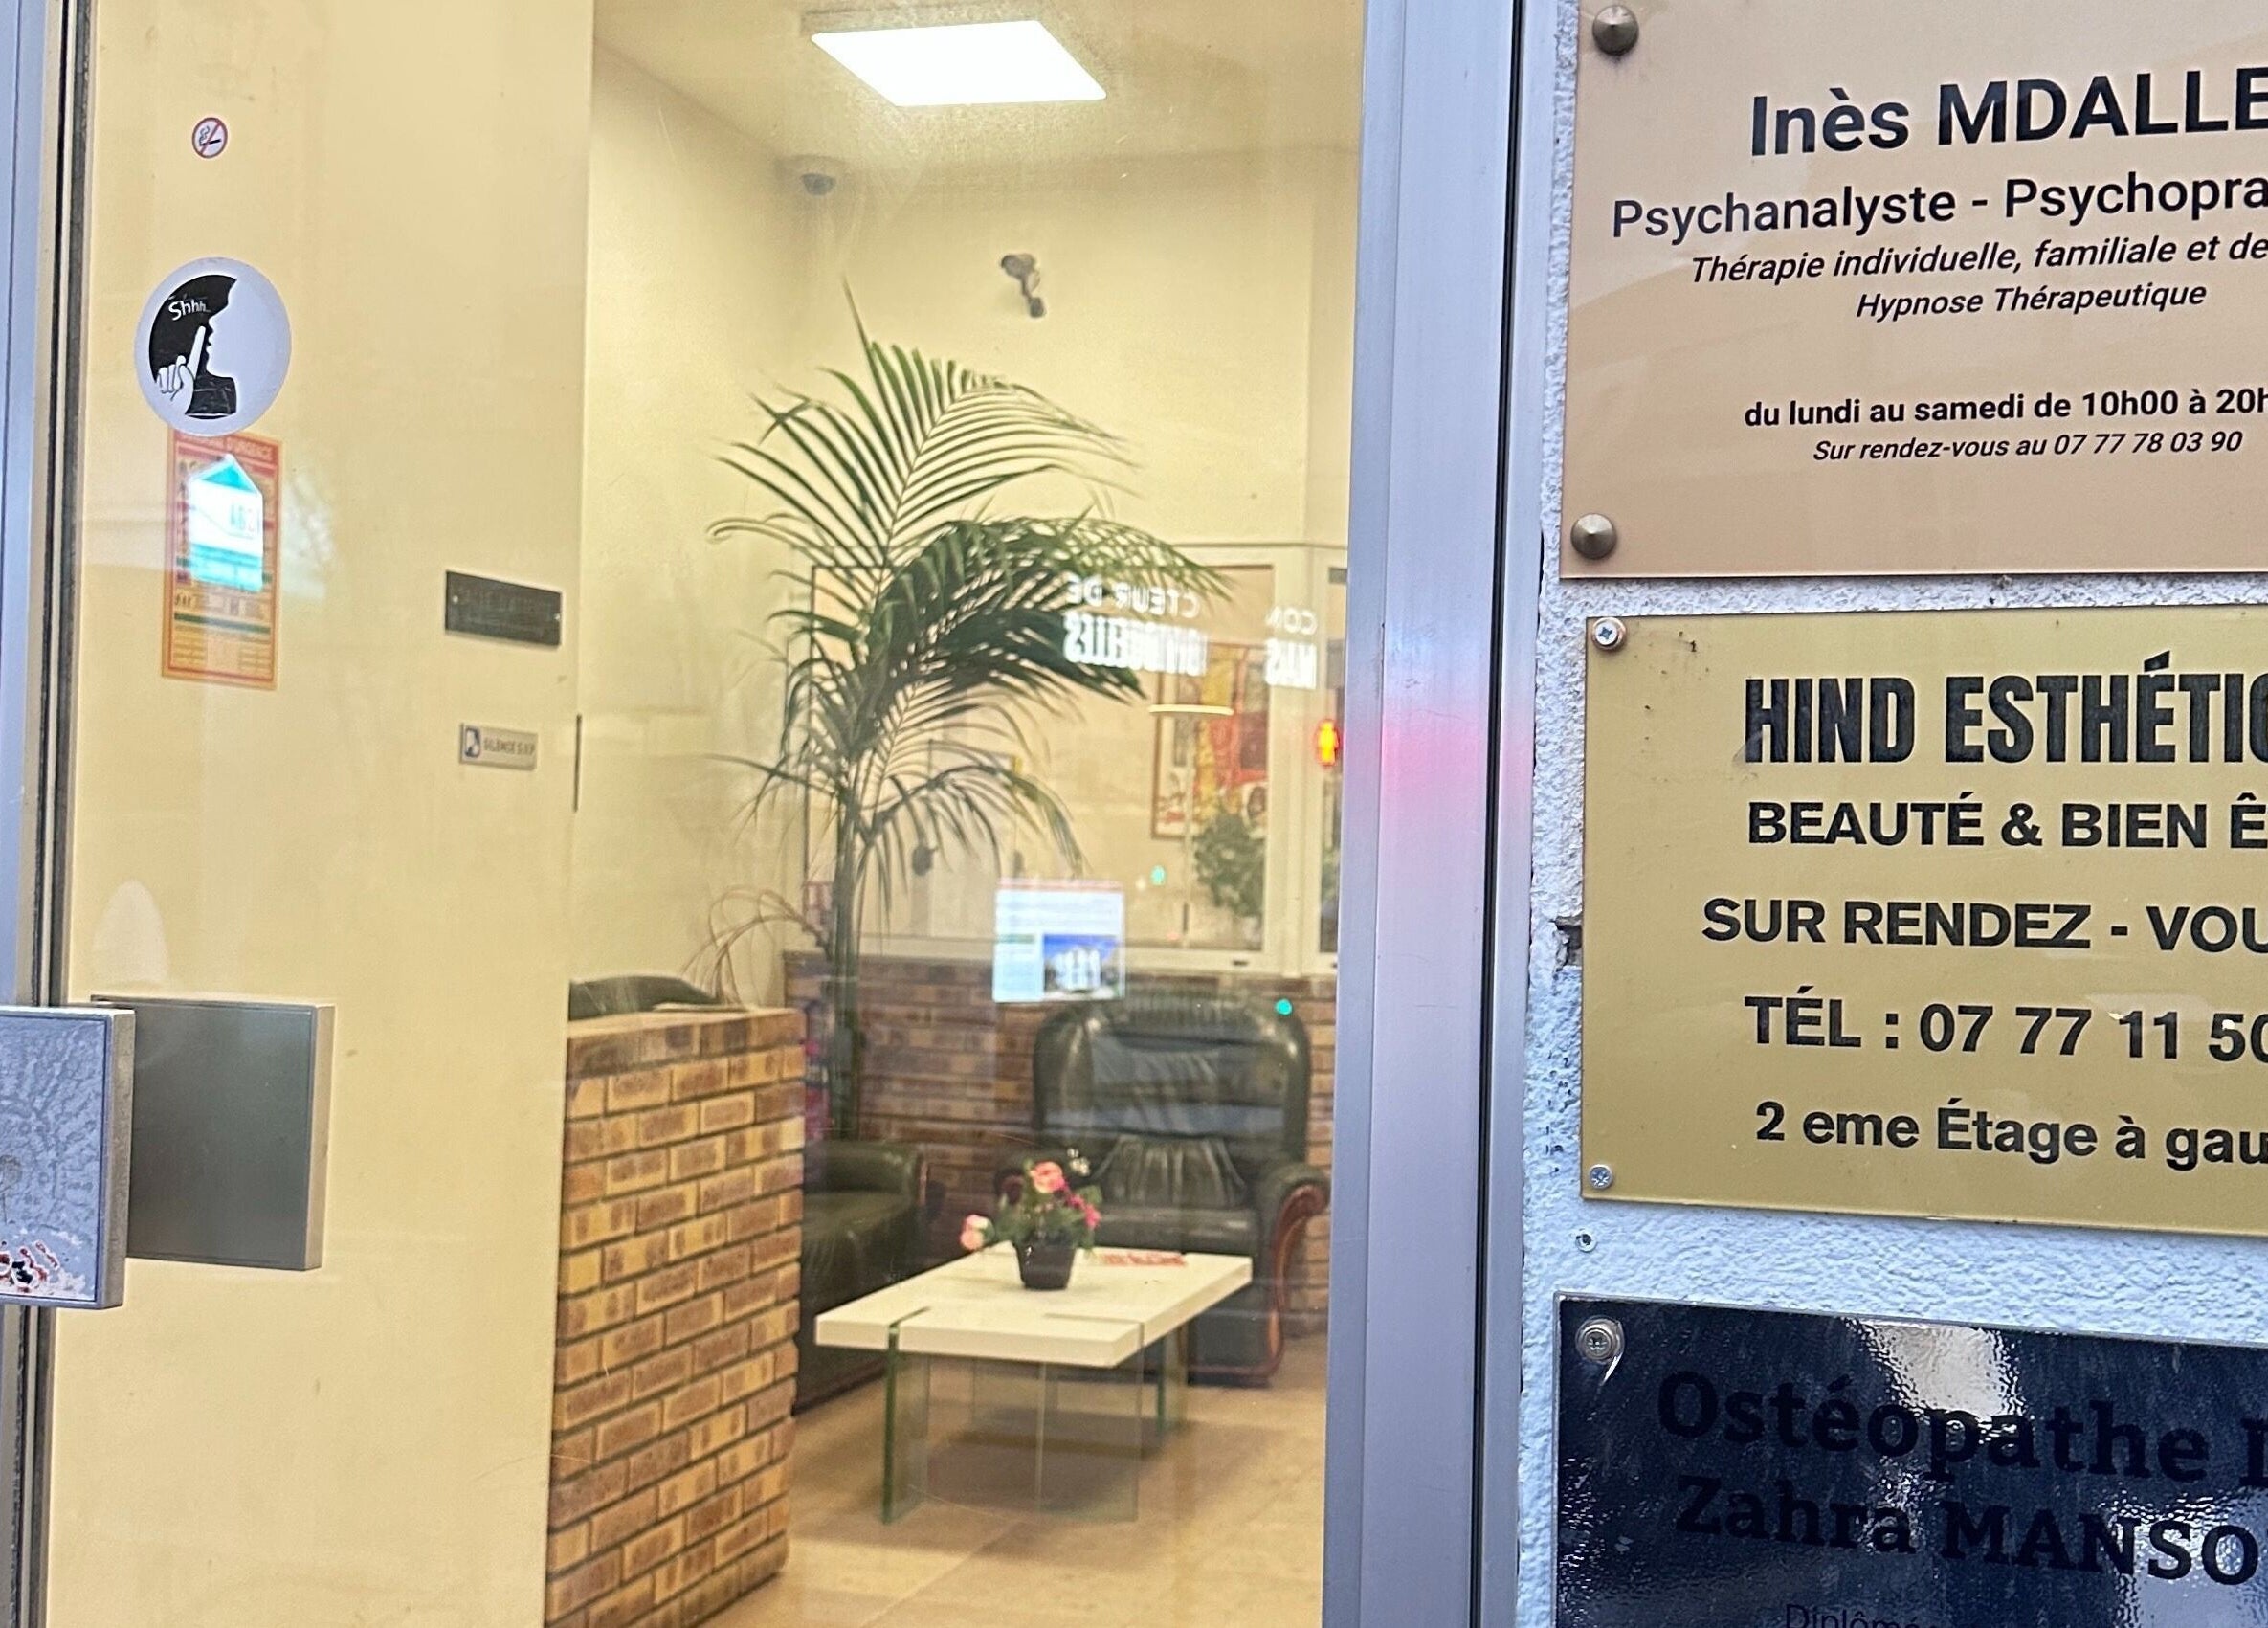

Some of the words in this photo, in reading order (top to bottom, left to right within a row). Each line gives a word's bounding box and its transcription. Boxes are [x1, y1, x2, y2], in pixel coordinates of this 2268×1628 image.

[1751, 87, 1909, 157] Inès
[1938, 66, 2268, 146] MDALLE
[1613, 185, 1956, 246] Psychanalyste
[2006, 170, 2268, 227] Psychopra
[1692, 255, 1825, 286] Thérapie
[1833, 241, 2021, 277] individuelle,
[2034, 234, 2177, 268] familiale
[2186, 235, 2221, 262] et
[2228, 231, 2268, 260] de
[1857, 293, 1984, 323] Hypnose
[1995, 284, 2207, 315] Thérapeutique
[1745, 401, 1780, 427] du
[1790, 398, 1860, 426] lundi
[1869, 403, 1905, 423] au
[1914, 393, 2024, 422] samedi
[2034, 391, 2072, 418] de
[2082, 390, 2179, 417] 10h00
[2189, 388, 2206, 415] à
[1812, 440, 1857, 461] Sur
[1858, 436, 2010, 459] rendez-vous
[2015, 439, 2048, 456] au
[2054, 434, 2088, 456] 07
[2093, 433, 2126, 455] 77
[2132, 432, 2165, 454] 78
[2170, 431, 2204, 453] 03
[2211, 430, 2243, 452] 90
[1745, 677, 1915, 764] HIND
[1748, 791, 1985, 847] BEAUTÉ
[2000, 802, 2043, 847] &
[2061, 803, 2207, 849] BIEN
[2230, 792, 2268, 849] Ê
[1701, 897, 1826, 943] SUR
[1844, 901, 2092, 949] RENDEZ
[2110, 926, 2128, 936] -
[2146, 905, 2268, 954] VOU
[1744, 985, 1862, 1048] TÉL
[1885, 1013, 1899, 1050] :
[1919, 1003, 1993, 1053] 07
[2015, 1006, 2092, 1056] 77
[2118, 1010, 2178, 1059] 11
[1756, 1101, 1786, 1142] 2
[1802, 1111, 1920, 1149] eme
[1937, 1097, 2098, 1165] Étage
[2114, 1114, 2146, 1159] à
[2165, 1127, 2268, 1171] gau
[1658, 1370, 2209, 1483] Ostéopathe
[1675, 1473, 1917, 1553] Zahra
[1941, 1500, 2259, 1587] MANSO
